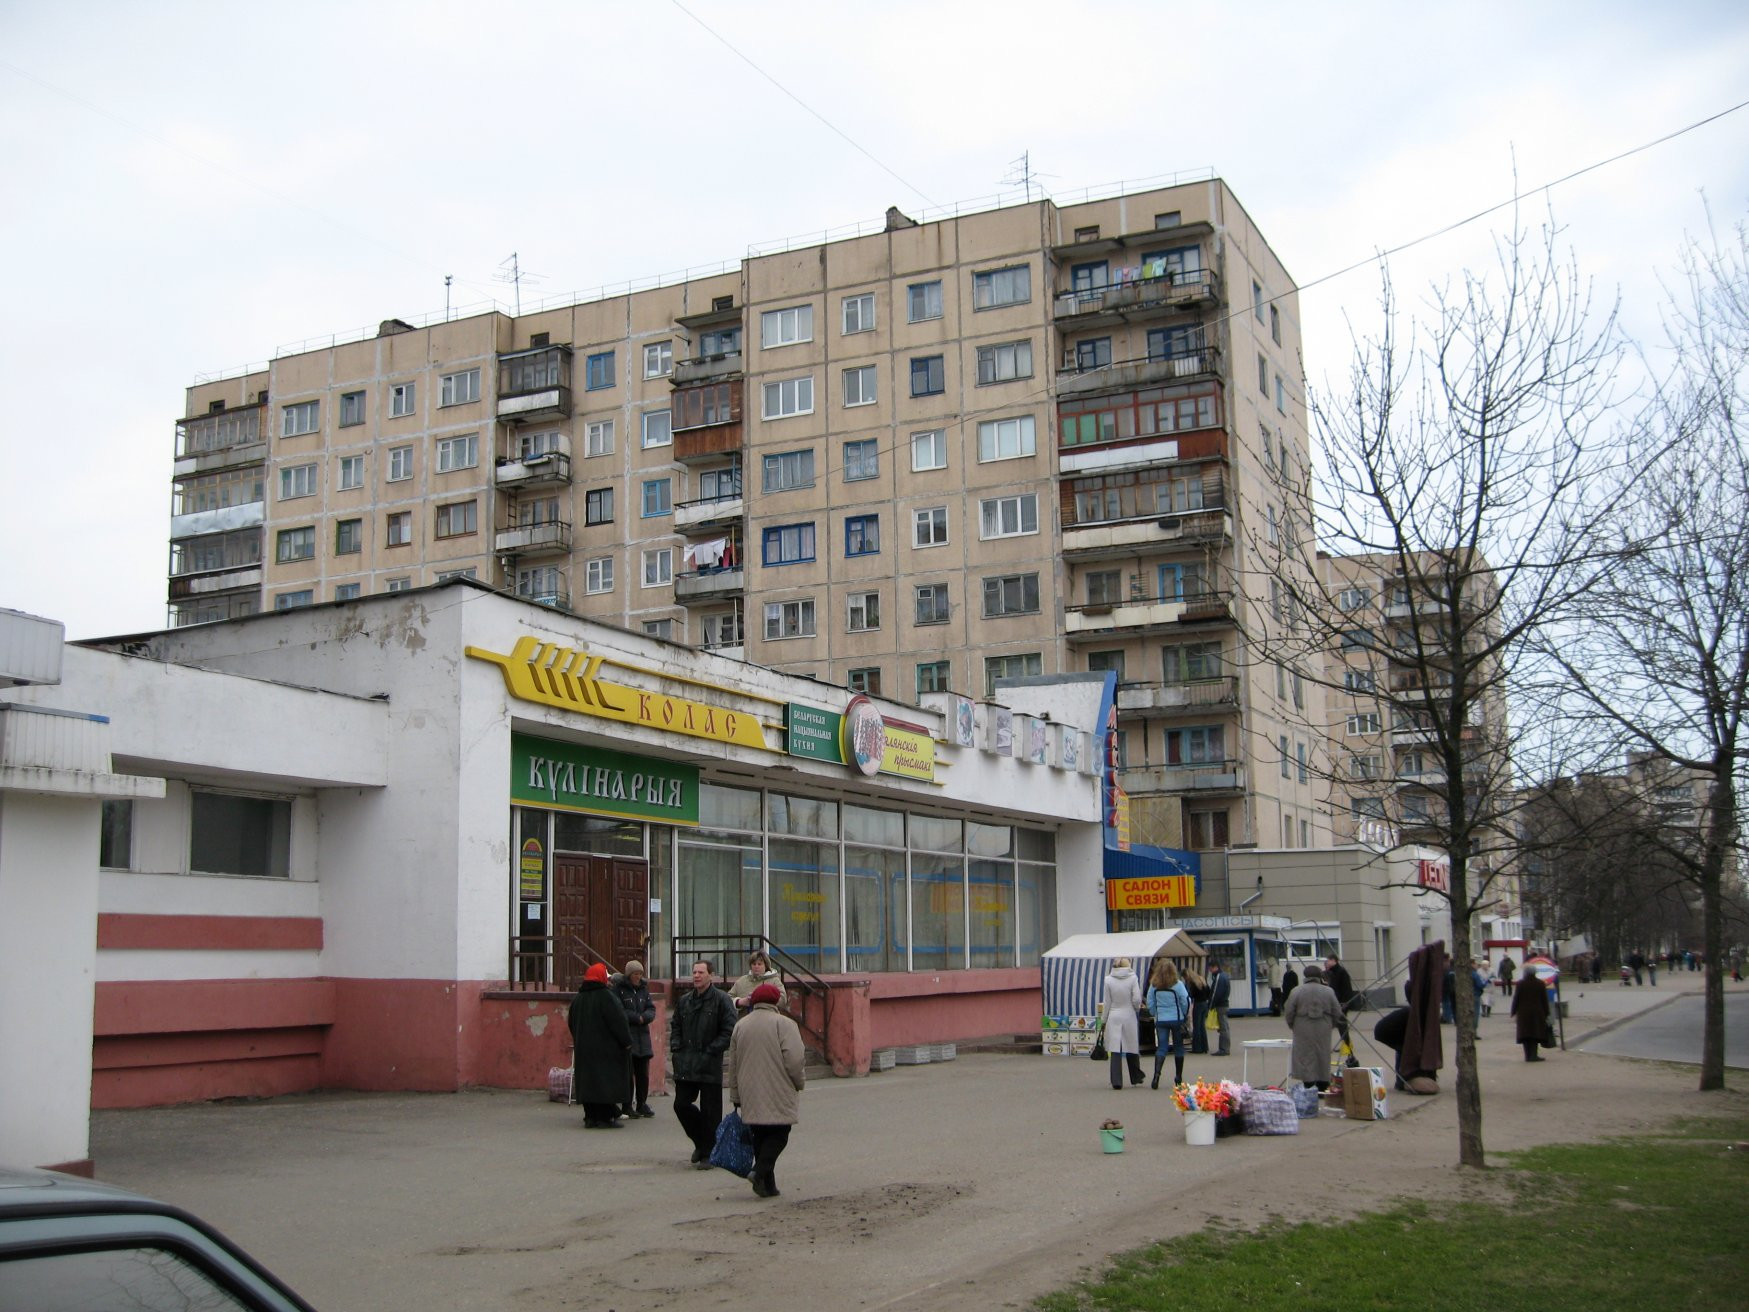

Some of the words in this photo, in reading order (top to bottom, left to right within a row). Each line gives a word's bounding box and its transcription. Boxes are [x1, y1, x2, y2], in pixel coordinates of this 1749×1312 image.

[638, 693, 737, 739] КОЛАС
[793, 738, 815, 752] КУХНЯ
[528, 755, 683, 807] КУЛІНАРЫЯ
[1122, 879, 1172, 893] САЛОН
[1126, 893, 1170, 906] СВЯЗИ
[1173, 916, 1254, 930] ЧАСОПІСЫ
